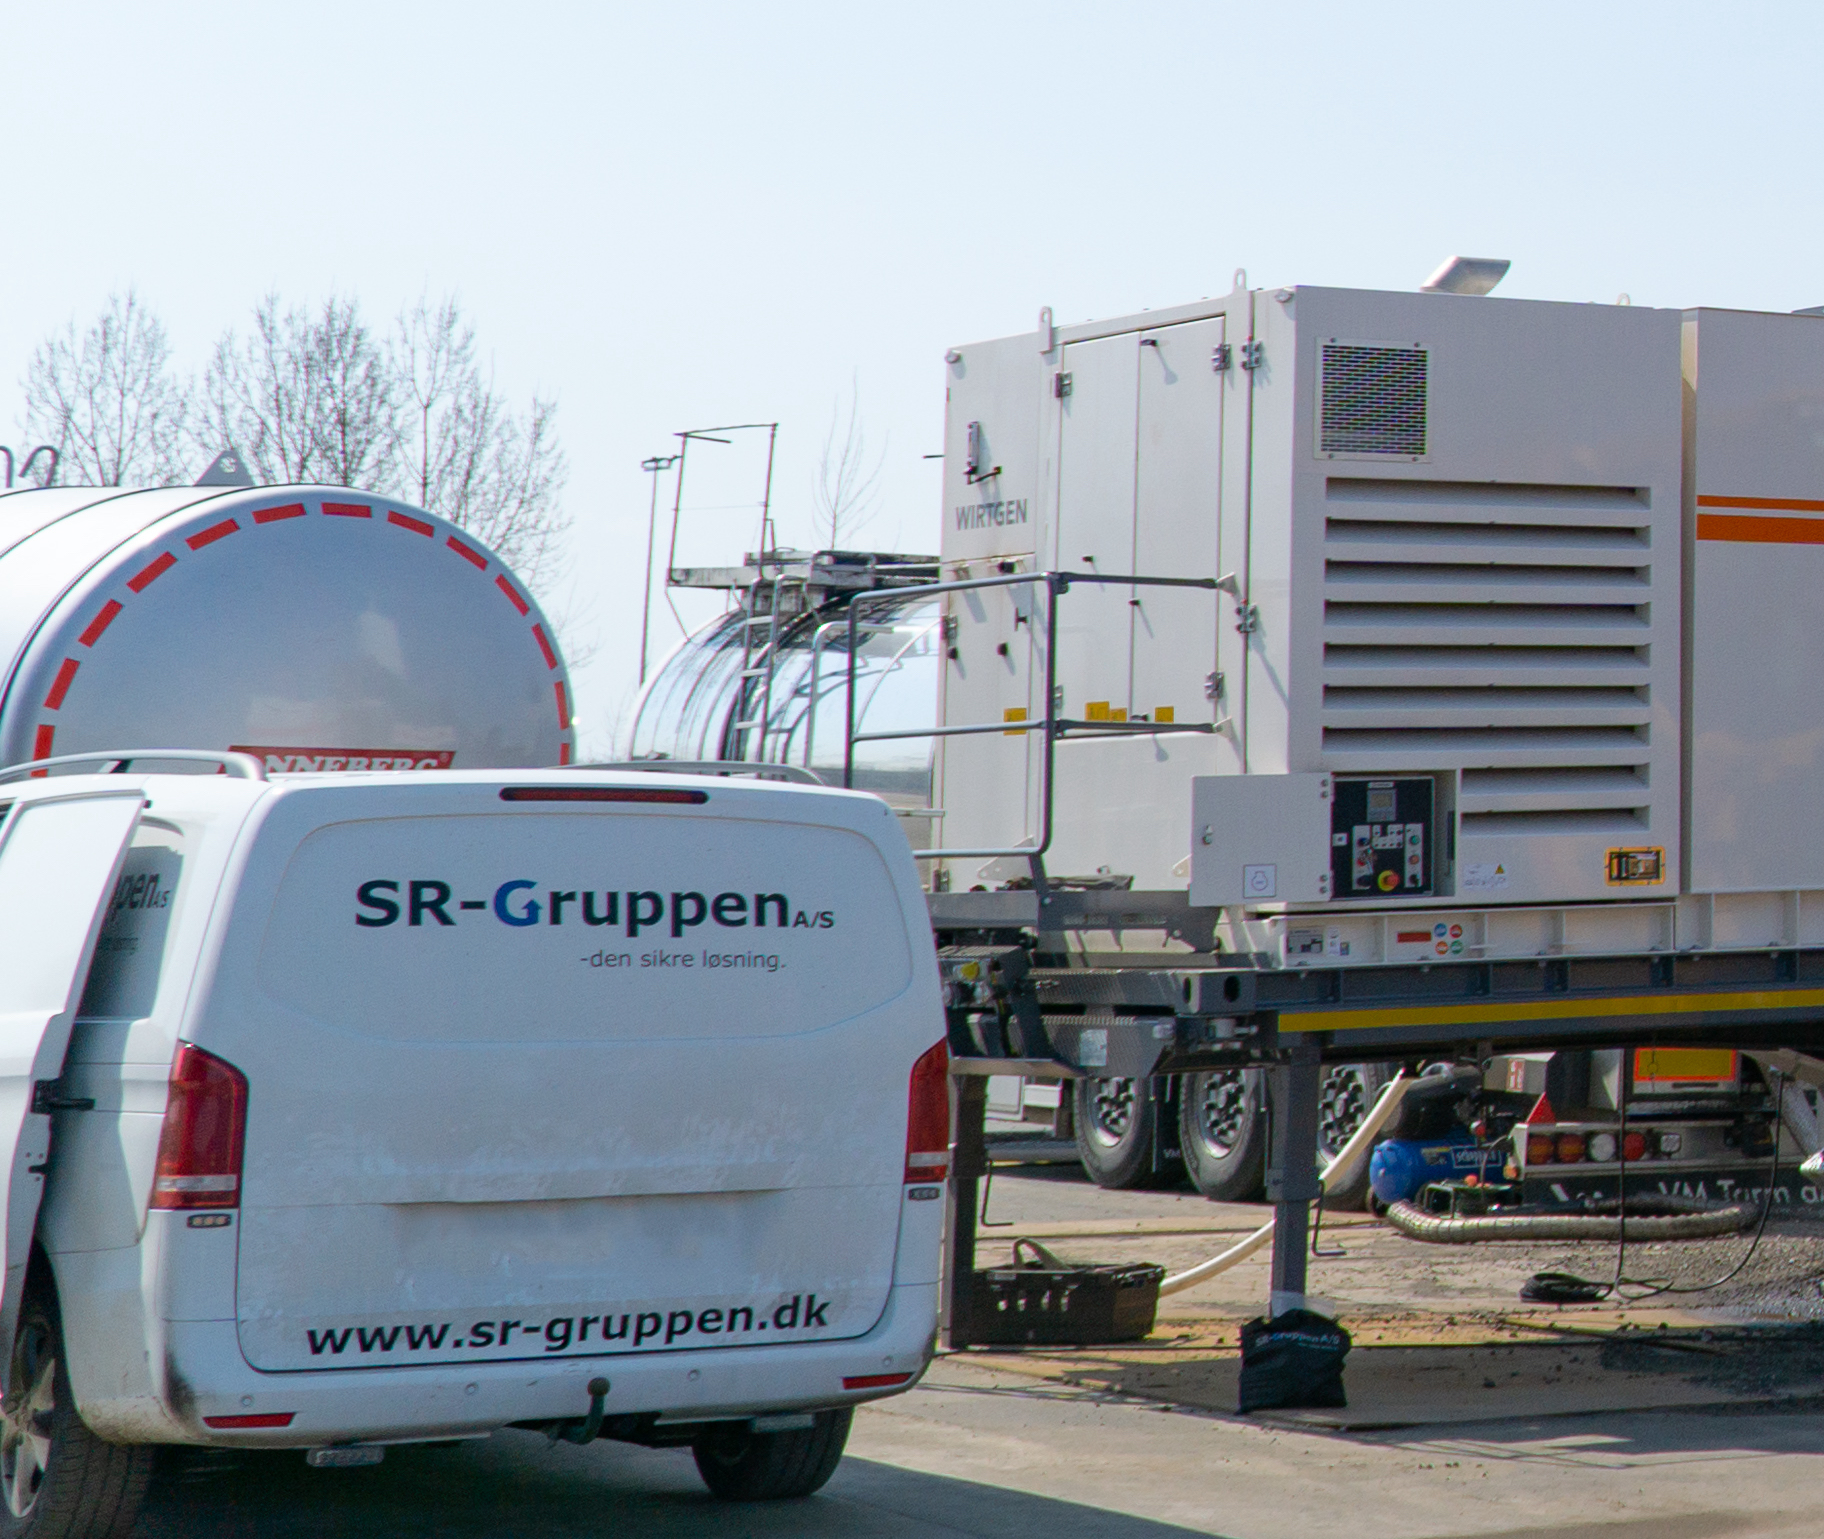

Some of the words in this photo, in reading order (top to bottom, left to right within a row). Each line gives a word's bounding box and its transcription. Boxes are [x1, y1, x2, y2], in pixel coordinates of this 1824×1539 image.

[955, 498, 1027, 531] WIRTGEN
[355, 879, 790, 938] SR-Gruppen
[792, 910, 836, 930] A/S
[580, 949, 632, 969] -den
[641, 949, 694, 969] sikre
[702, 949, 788, 973] løsning.
[306, 1293, 831, 1356] www.sr-gruppen.dk
